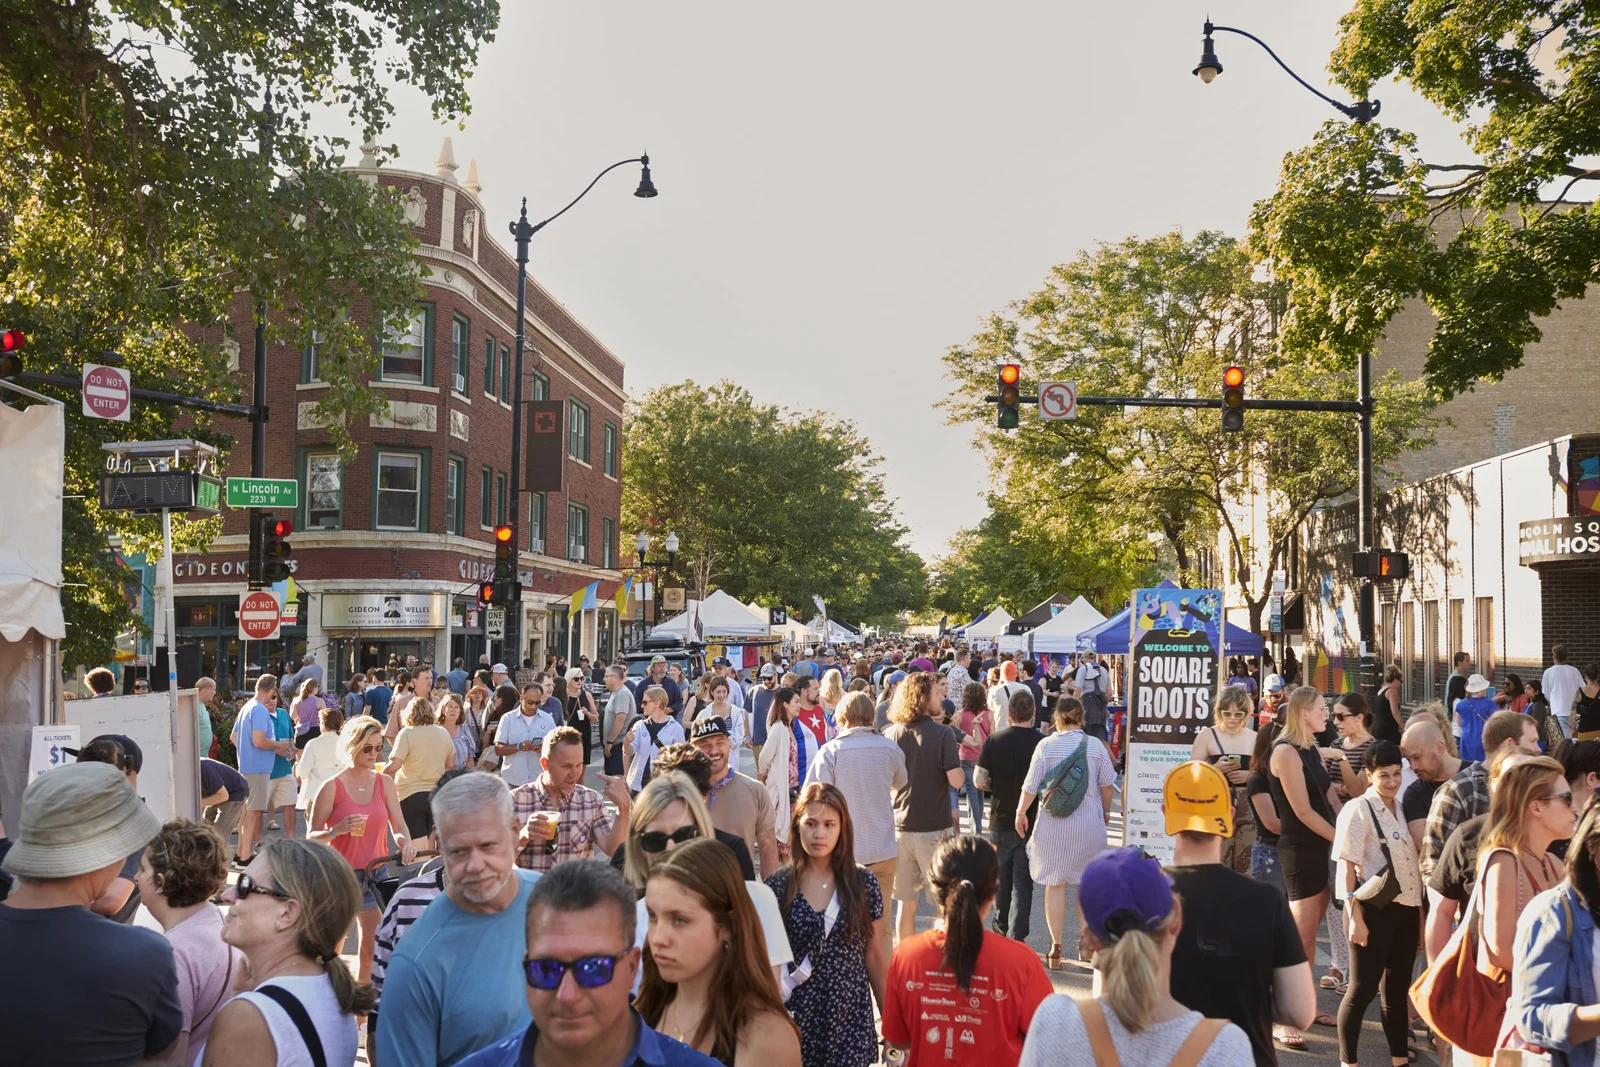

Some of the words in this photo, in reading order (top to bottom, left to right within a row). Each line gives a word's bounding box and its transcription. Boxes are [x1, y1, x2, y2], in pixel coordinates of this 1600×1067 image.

[90, 374, 102, 384] DO
[106, 377, 122, 387] NOT
[93, 398, 119, 410] ENTER
[110, 476, 184, 504] ATM
[242, 482, 280, 494] Lincoln
[175, 562, 246, 577] GIDEON
[246, 601, 255, 609] DO
[260, 601, 274, 609] NOT
[1139, 656, 1212, 684] SQUARE
[1138, 686, 1209, 720] ROOTS
[698, 722, 719, 736] AHA
[1137, 724, 1163, 732] JULY
